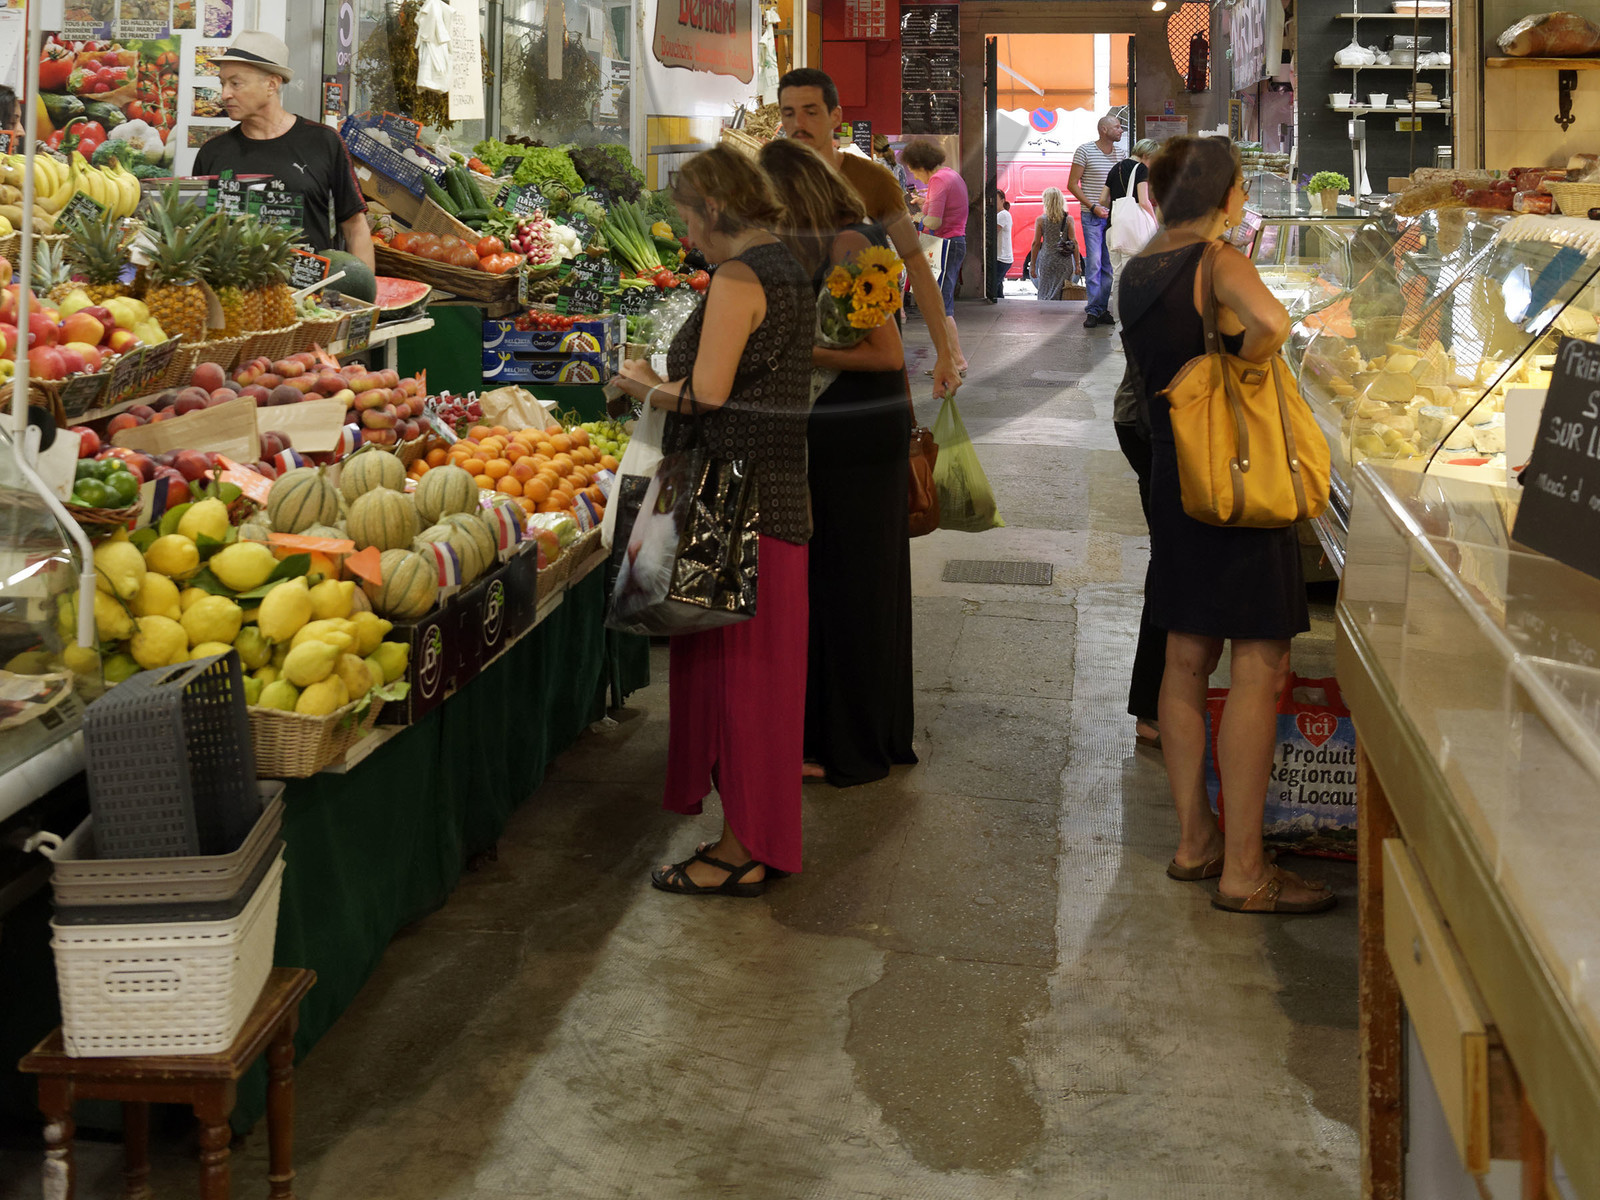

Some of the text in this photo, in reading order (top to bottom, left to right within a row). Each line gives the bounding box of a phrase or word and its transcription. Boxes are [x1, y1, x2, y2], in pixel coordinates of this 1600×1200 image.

[574, 289, 599, 302] 6,20
[503, 366, 530, 375] BELORTA
[1545, 416, 1584, 452] SUR
[1304, 718, 1330, 736] ici
[1282, 743, 1356, 765] Produit
[1270, 763, 1357, 787] Régionau
[1280, 784, 1357, 806] et Locau
